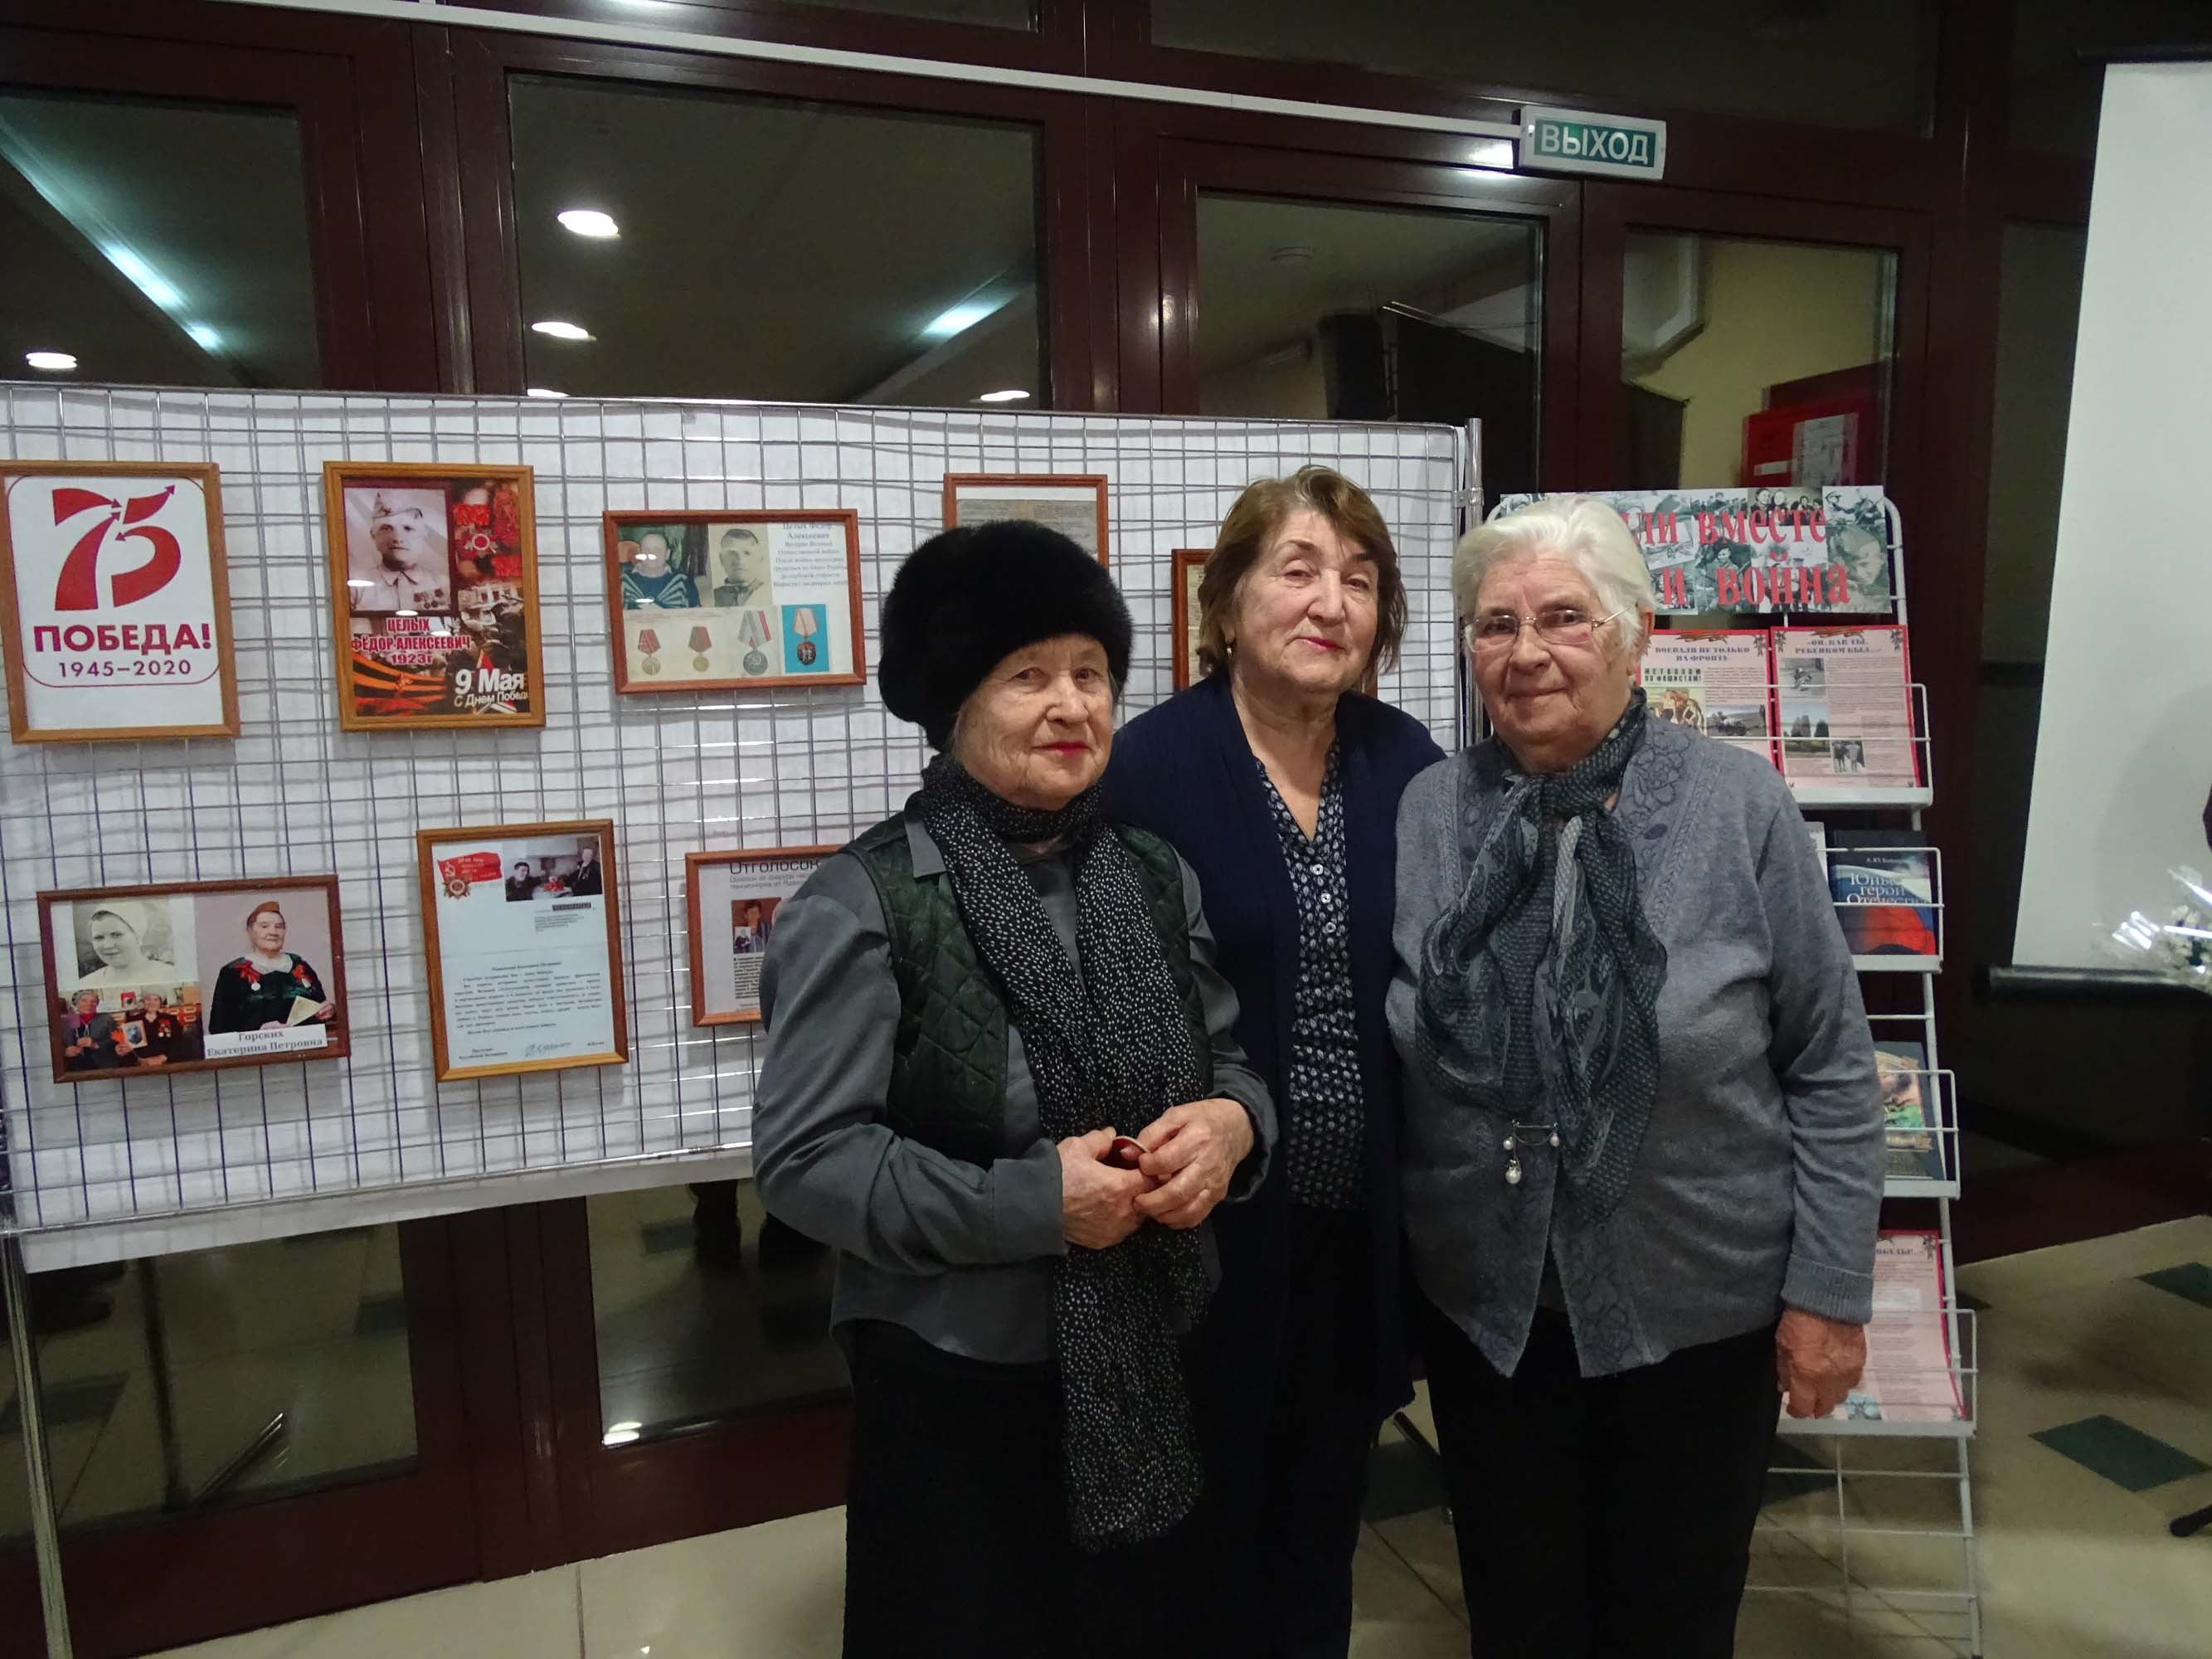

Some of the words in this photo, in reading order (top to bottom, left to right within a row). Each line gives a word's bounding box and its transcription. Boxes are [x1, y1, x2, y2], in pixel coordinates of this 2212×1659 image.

[1541, 124, 1649, 164] ВЫХОД
[1697, 509, 1826, 544] вместе
[1660, 567, 1686, 606] и
[1715, 549, 1850, 606] война
[386, 617, 430, 634] ЦЕЛЫХ
[33, 623, 211, 656] ПОБЕДА!
[396, 635, 471, 651] АЛЕКСЕЕВИЧ
[455, 669, 472, 694] 9
[477, 668, 524, 693] Мая
[454, 696, 464, 707] С
[464, 694, 495, 708] Днем
[239, 1030, 284, 1042] Горских
[207, 1044, 268, 1057] Екатерина
[270, 1039, 323, 1052] Петровна
